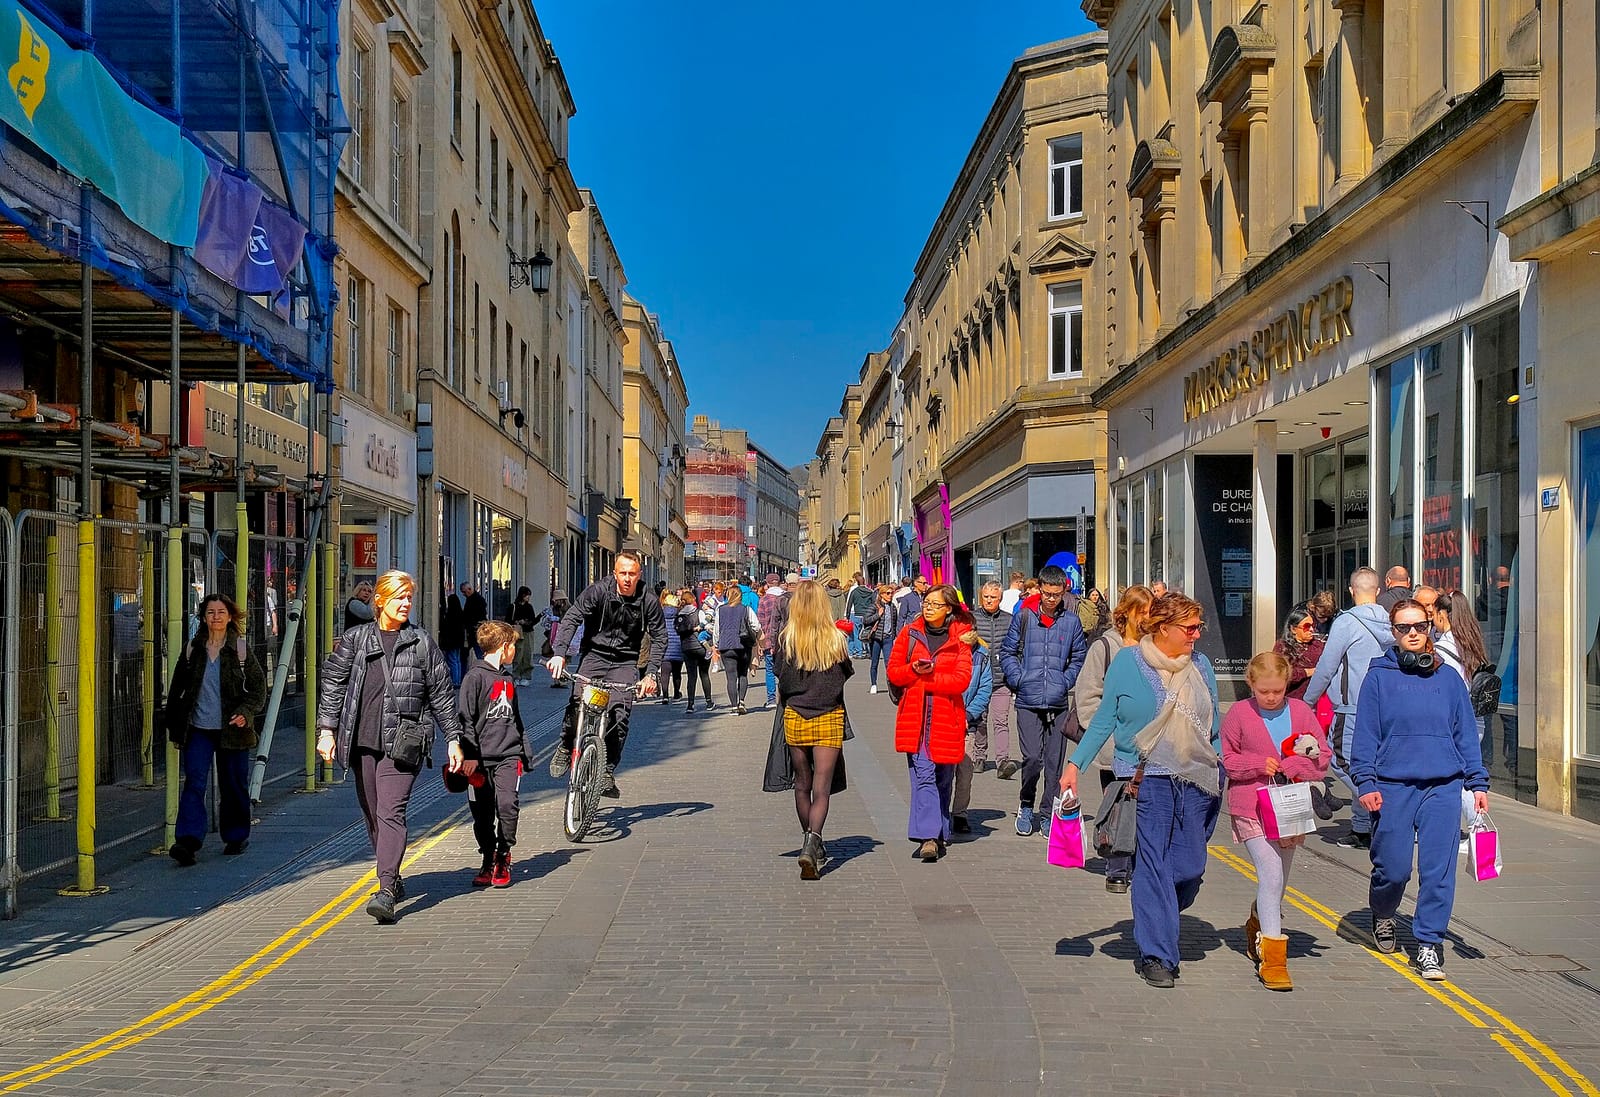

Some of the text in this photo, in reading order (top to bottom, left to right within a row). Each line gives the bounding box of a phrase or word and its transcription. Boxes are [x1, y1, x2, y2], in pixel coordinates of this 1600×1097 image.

[249, 234, 269, 253] BT
[1183, 275, 1354, 423] MARKS & SPENCER
[205, 407, 229, 436] THE
[1222, 489, 1253, 499] BURE
[1212, 502, 1253, 512] DE CHA
[1423, 493, 1451, 523] NEW
[363, 541, 373, 551] UP
[364, 551, 377, 564] 75
[1422, 566, 1461, 593] STYLE
